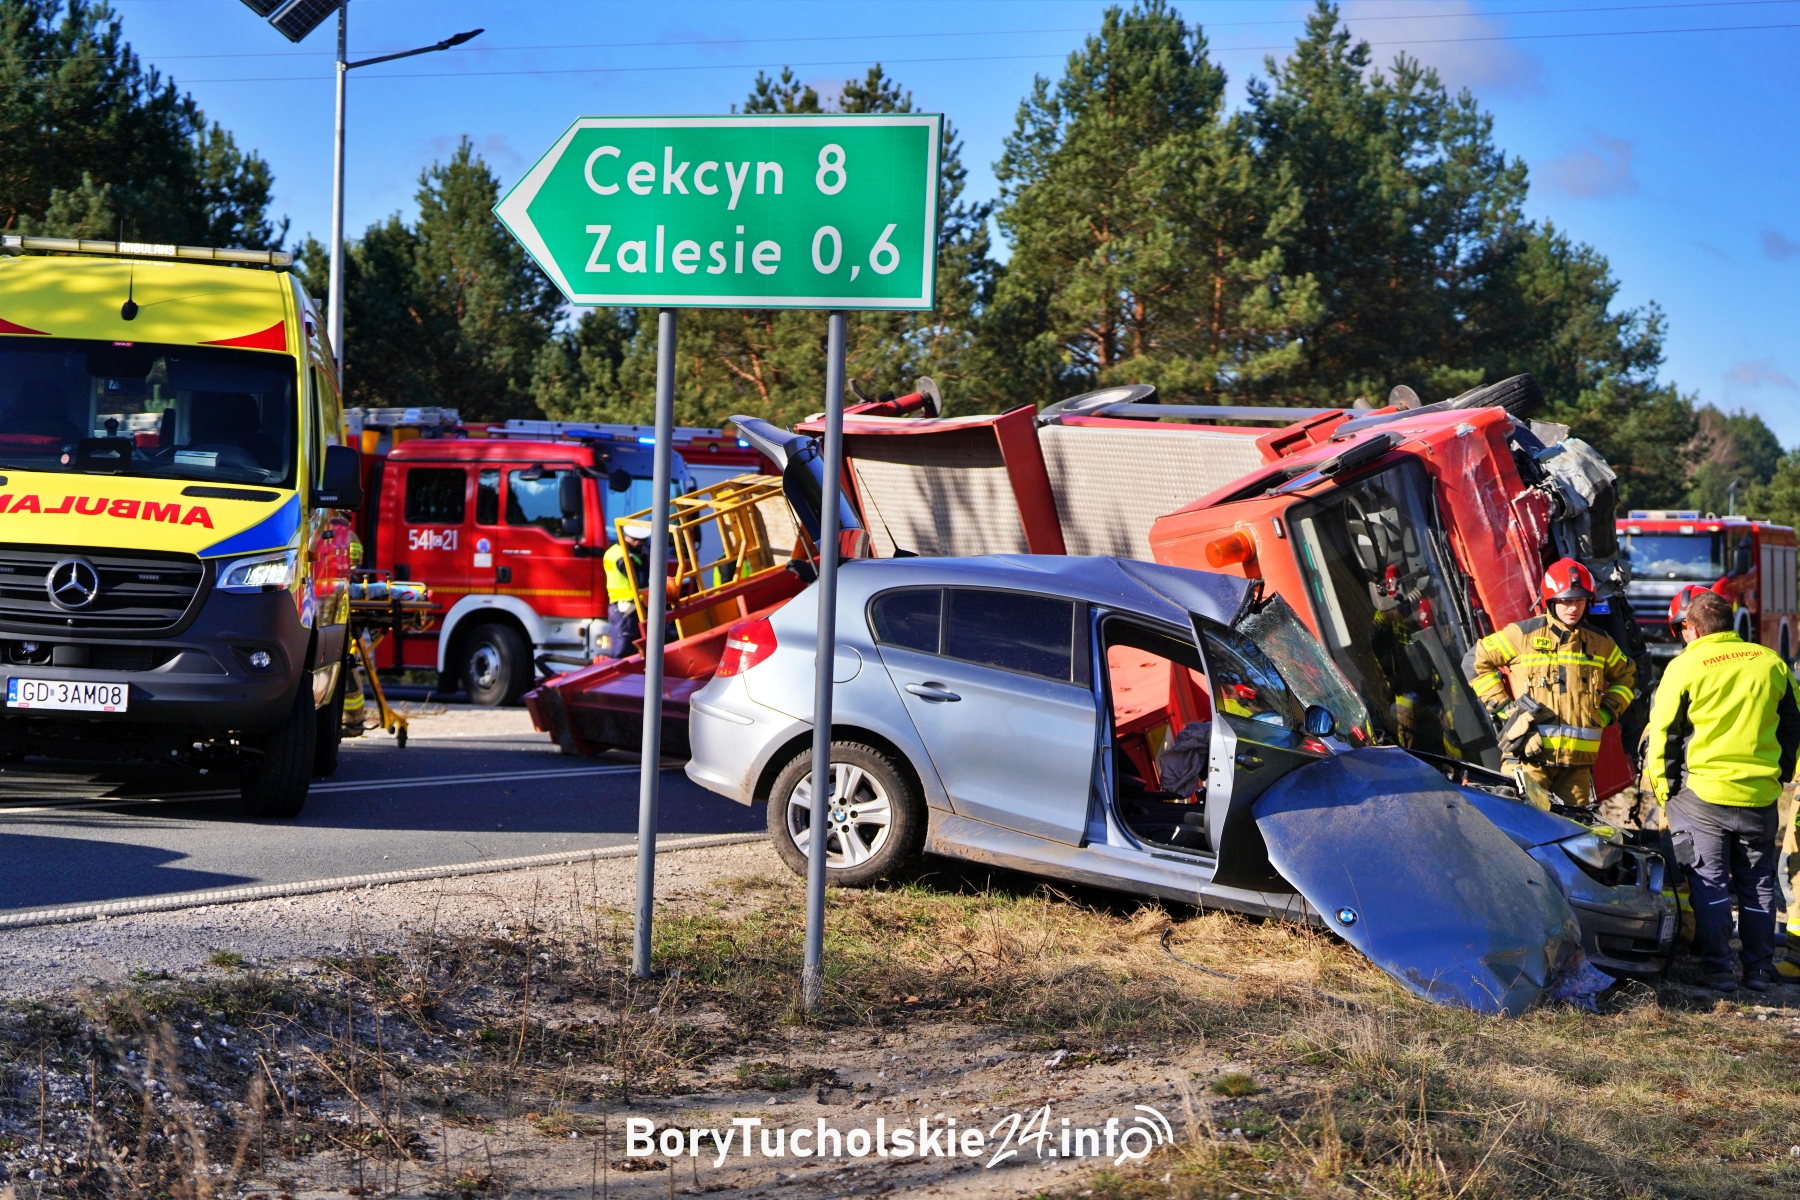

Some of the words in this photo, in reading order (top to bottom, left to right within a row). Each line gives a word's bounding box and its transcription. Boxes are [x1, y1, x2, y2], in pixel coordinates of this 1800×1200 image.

[584, 145, 783, 210] Cekcyn
[815, 143, 847, 195] 8
[120, 242, 175, 256] AMBULANS
[584, 224, 782, 275] Zalesie
[811, 223, 900, 283] 0,6
[1536, 638, 1550, 646] PSP
[23, 682, 49, 702] GD
[58, 684, 121, 705] 3AM08
